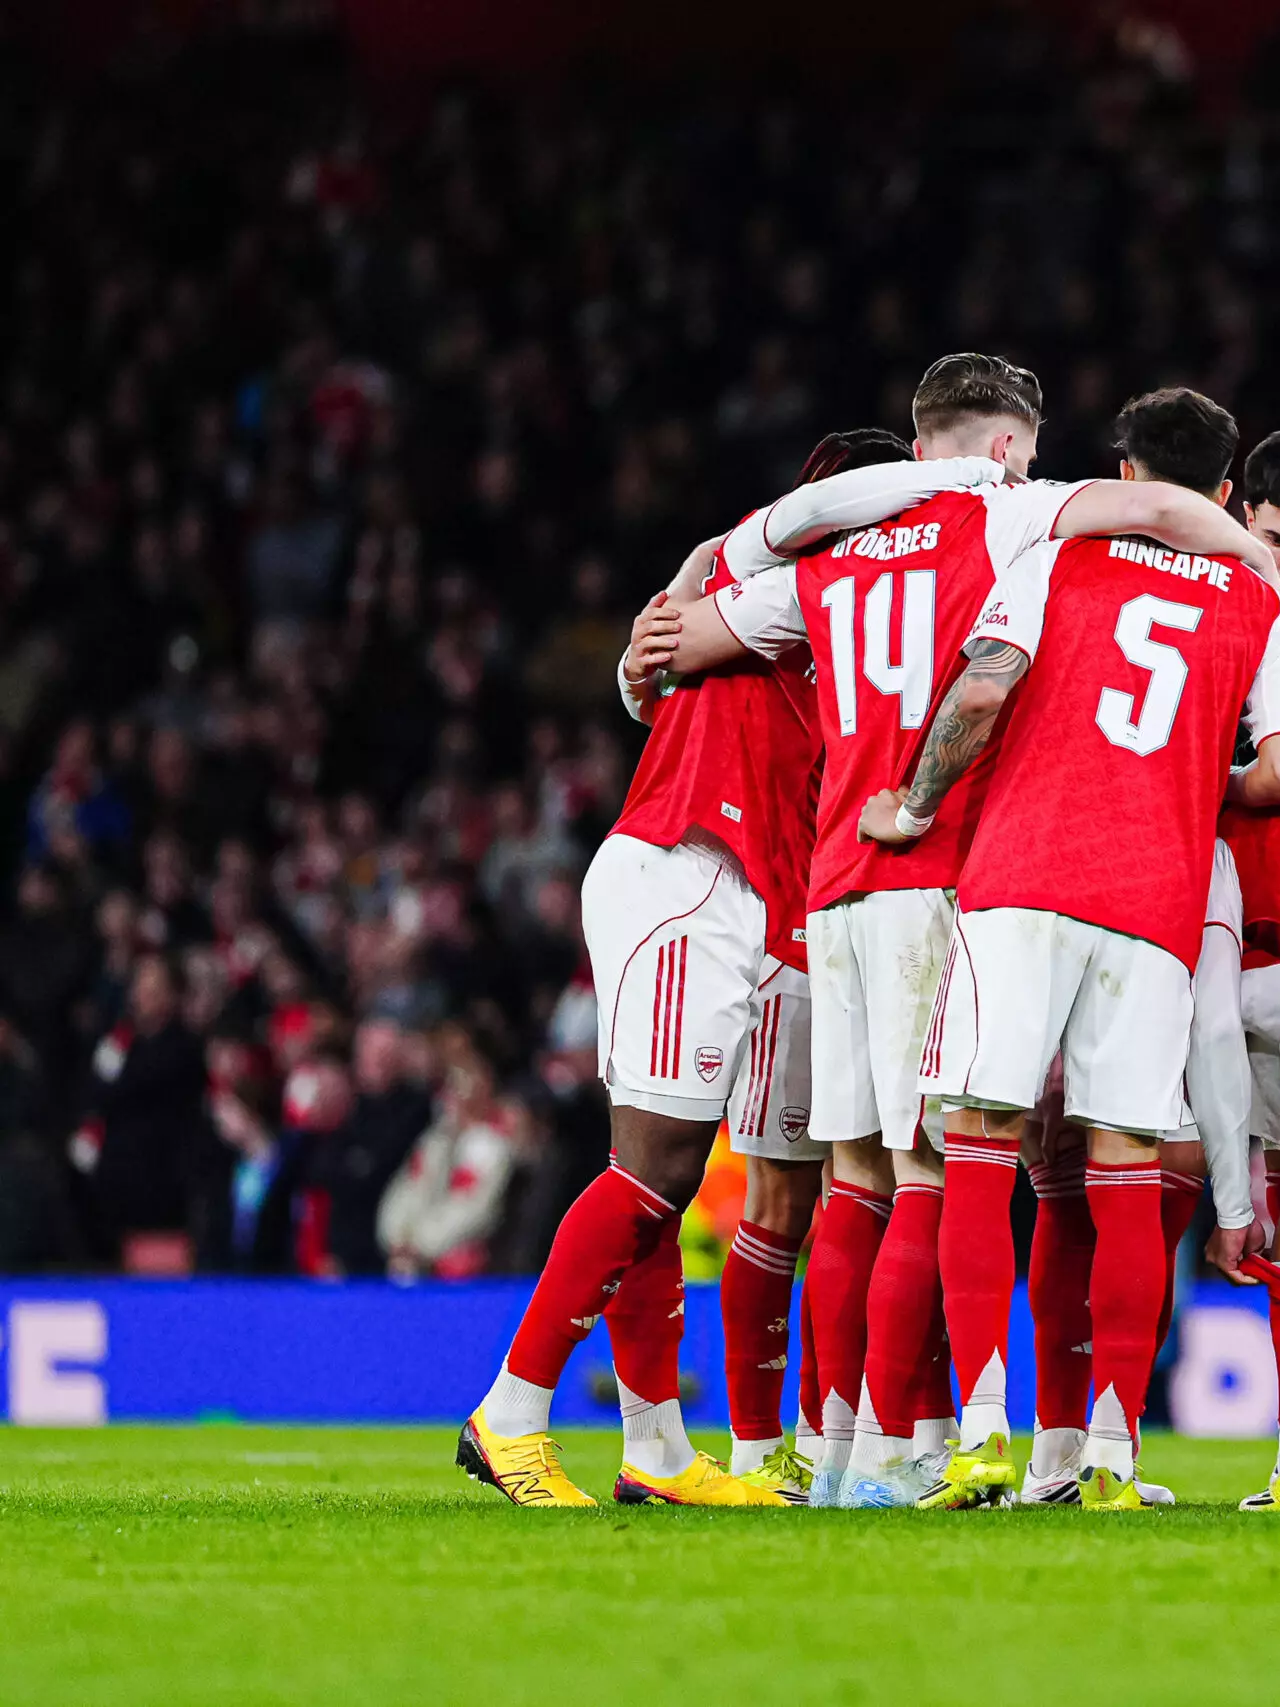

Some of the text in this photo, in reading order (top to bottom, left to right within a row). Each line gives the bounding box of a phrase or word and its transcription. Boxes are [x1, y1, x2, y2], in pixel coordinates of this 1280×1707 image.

[820, 569, 938, 738] 14
[1094, 593, 1204, 757] 5
[699, 1052, 721, 1060] Arsenal
